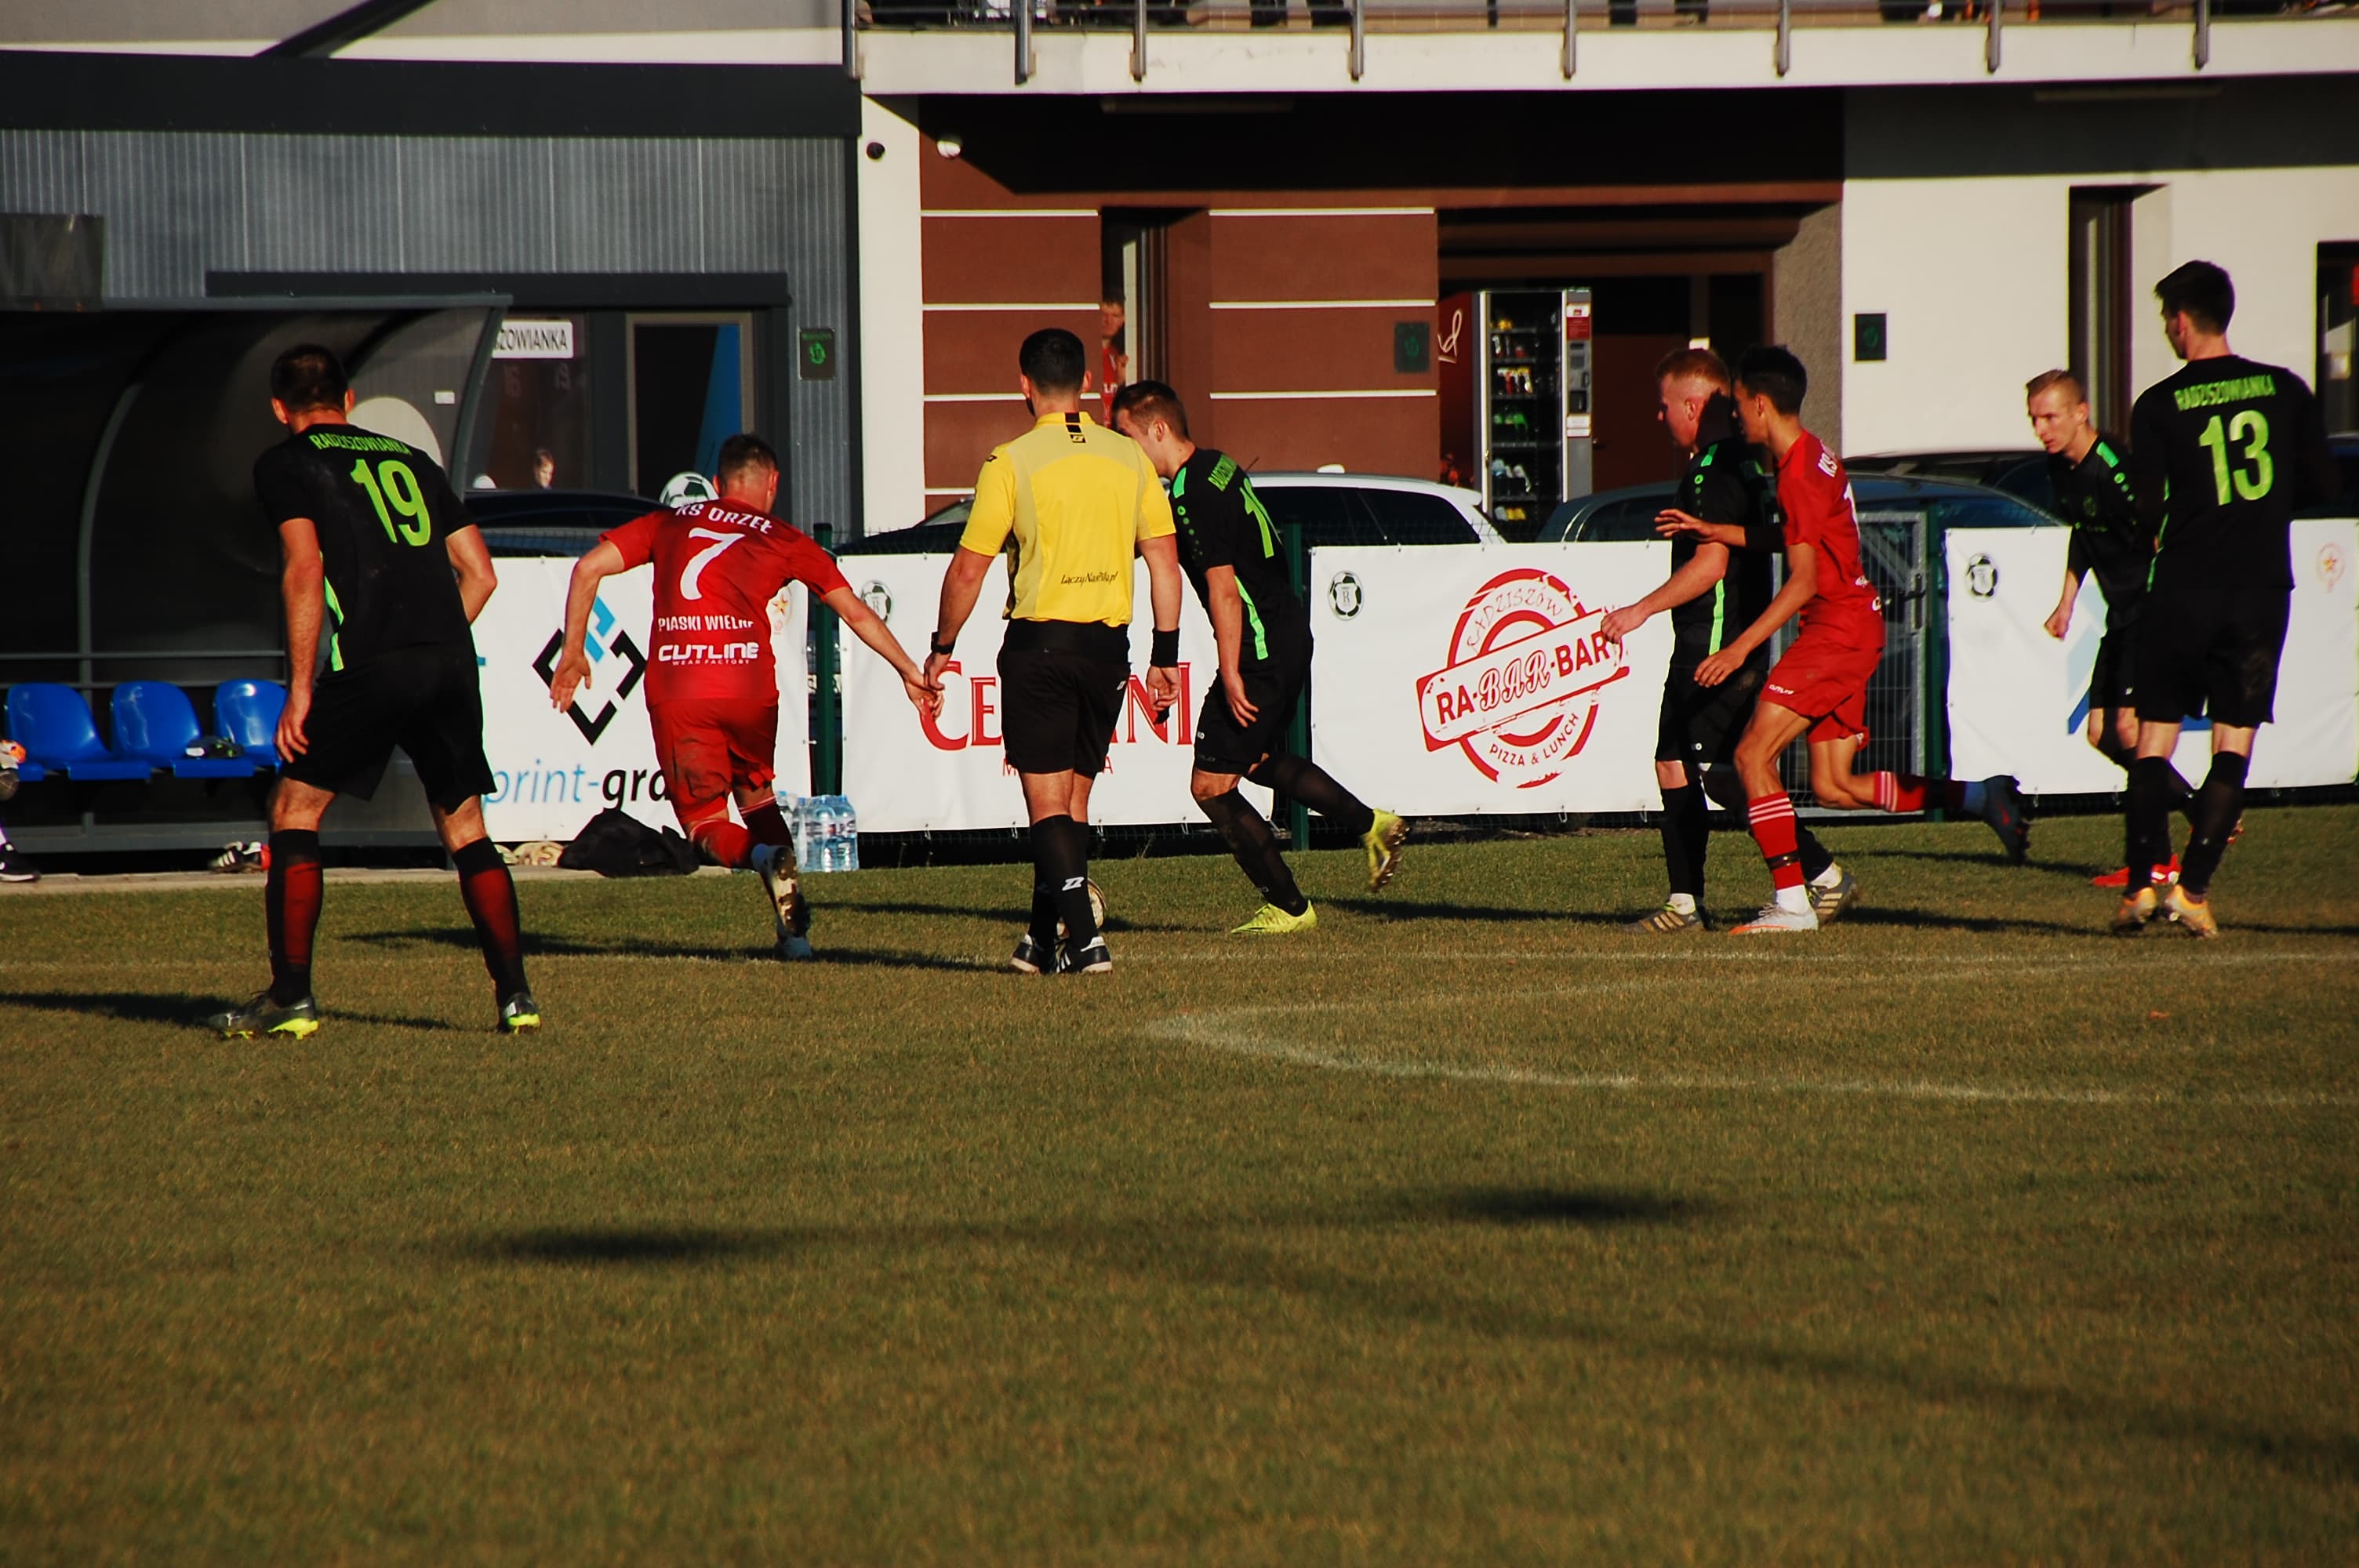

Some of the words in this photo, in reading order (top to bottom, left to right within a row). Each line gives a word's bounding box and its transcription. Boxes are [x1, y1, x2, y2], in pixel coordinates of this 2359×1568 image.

[495, 328, 569, 351] ZOWIANKA
[2199, 409, 2274, 506] 13
[350, 459, 431, 546] 19
[680, 527, 746, 601] 7
[657, 615, 701, 632] PIASKI
[658, 641, 759, 662] CUTLINE
[1489, 743, 1525, 766] PIZZA
[1531, 753, 1539, 765] &
[1543, 713, 1579, 758] LUNCH
